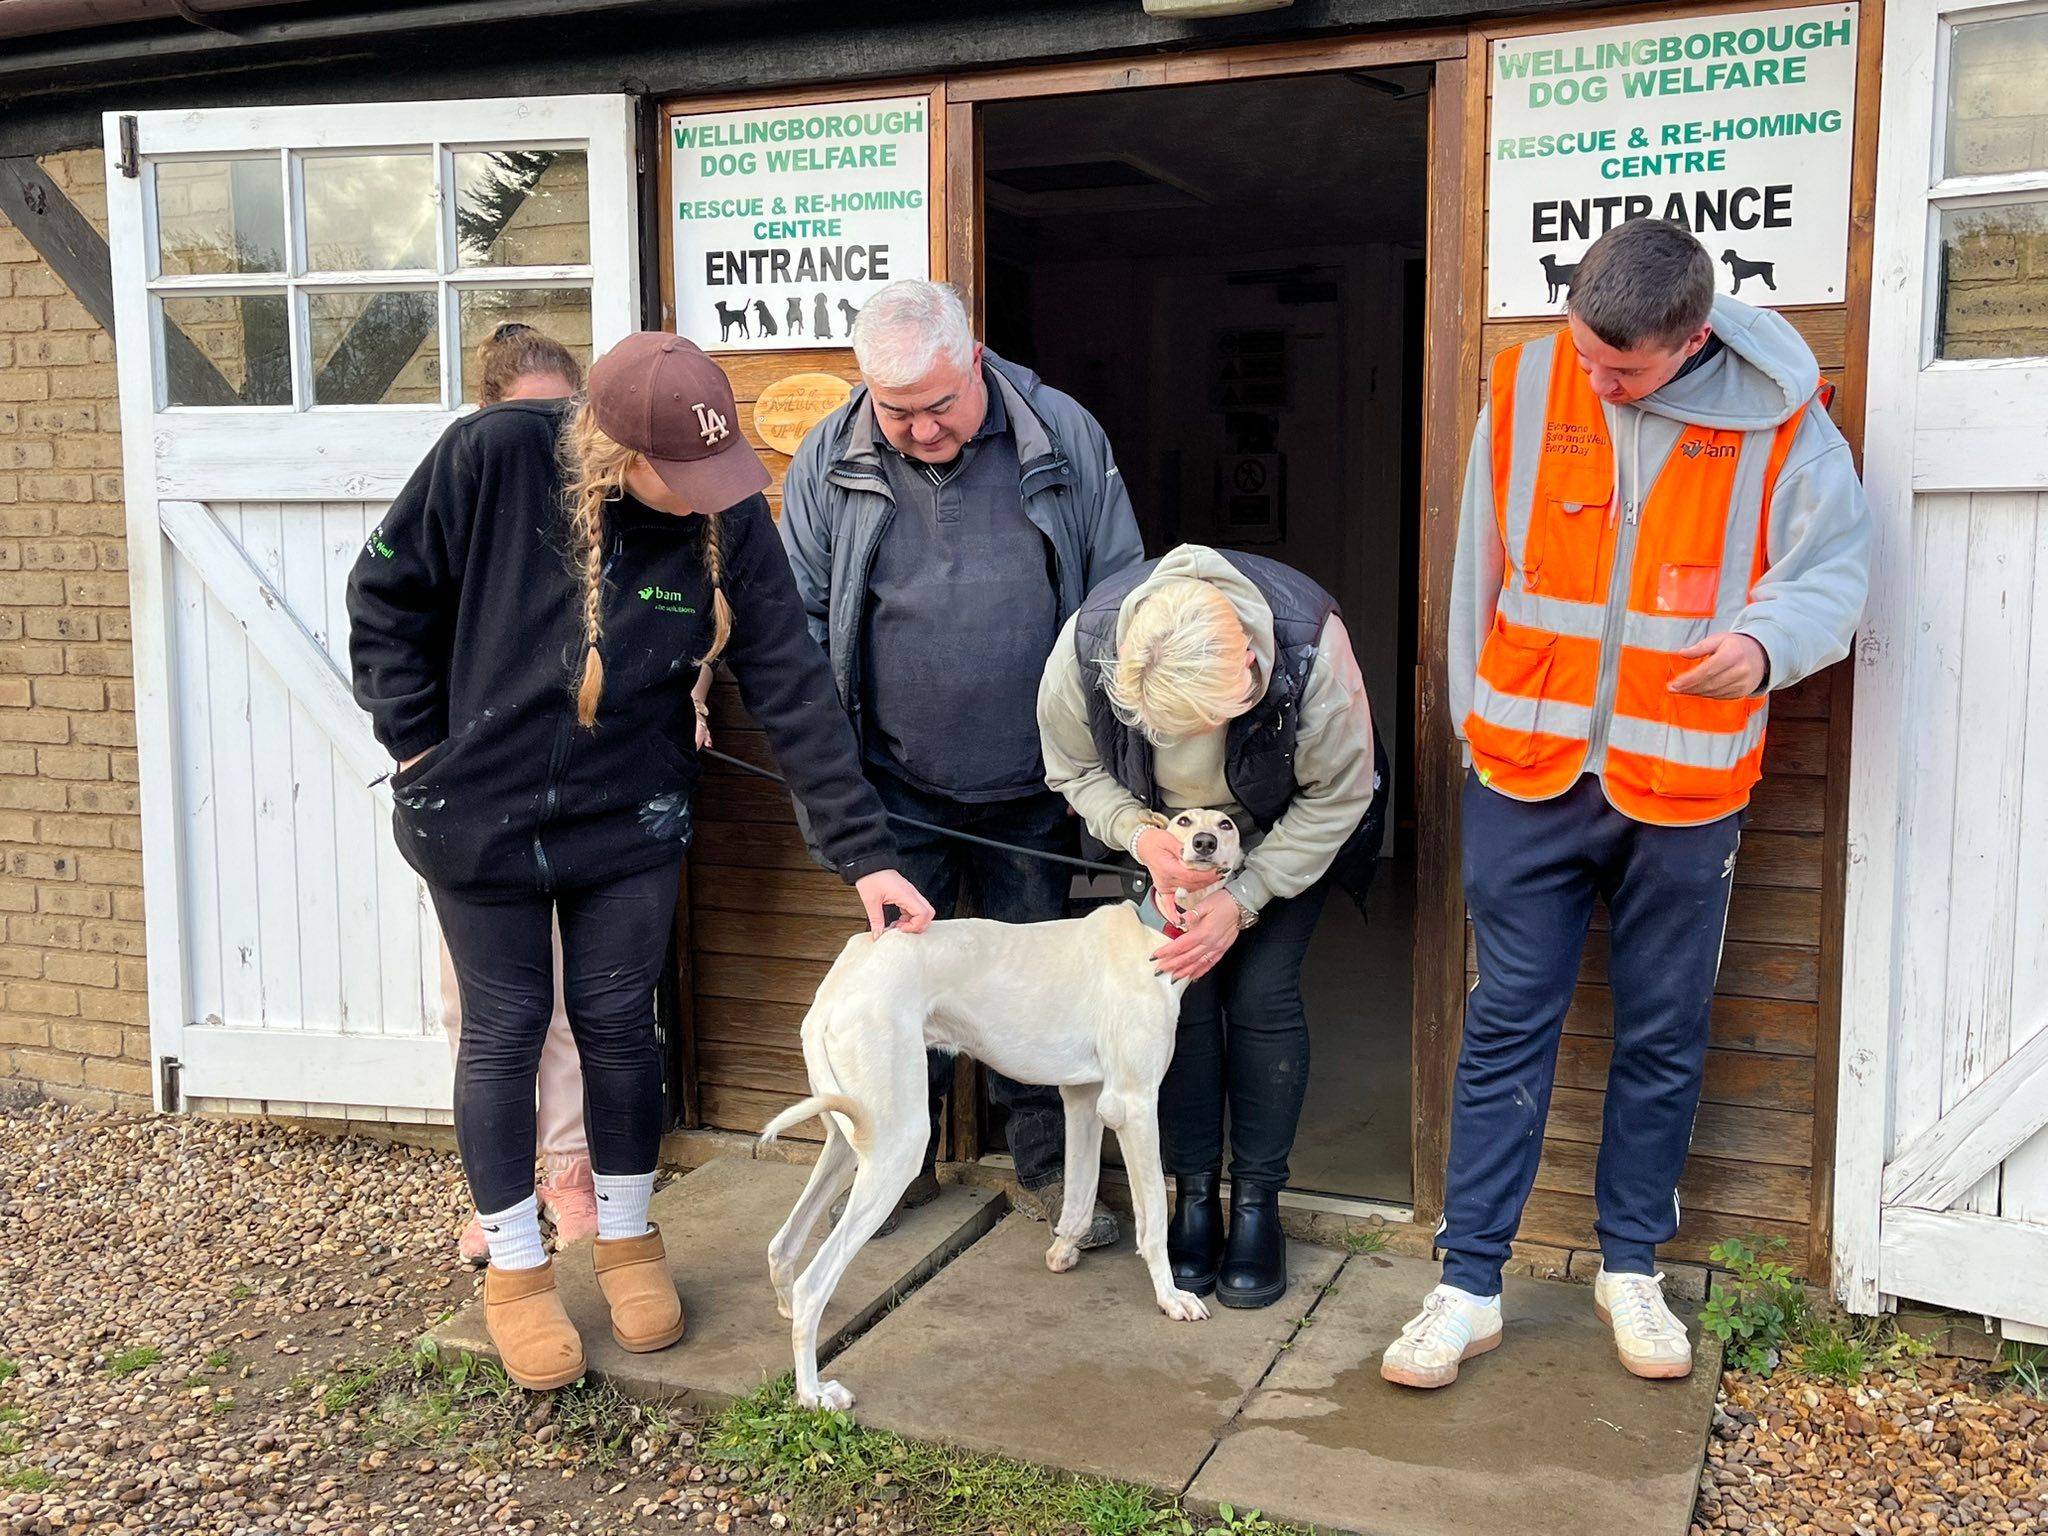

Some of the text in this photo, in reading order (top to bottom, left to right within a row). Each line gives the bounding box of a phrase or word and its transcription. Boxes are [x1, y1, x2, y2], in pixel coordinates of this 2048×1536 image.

[1498, 19, 1851, 80] WELLINGBOROUGH
[1529, 56, 1807, 109] DOG WELFARE
[674, 110, 923, 149] WELLINGBOROUGH
[1498, 109, 1842, 160] RESCUE & RE-HOMING
[701, 143, 897, 177] DOG WELFARE
[1601, 149, 1726, 179] CENTRE
[679, 189, 923, 220] RESCUE & RE-HOMING
[1532, 184, 1793, 243] ENTRANCE
[753, 218, 842, 240] CENTRE
[706, 244, 889, 285] ENTRANCE
[691, 403, 730, 446] LA
[1547, 421, 1589, 433] Everyone
[1570, 444, 1590, 457] Day
[1704, 440, 1736, 458] bam
[655, 586, 682, 602] bam
